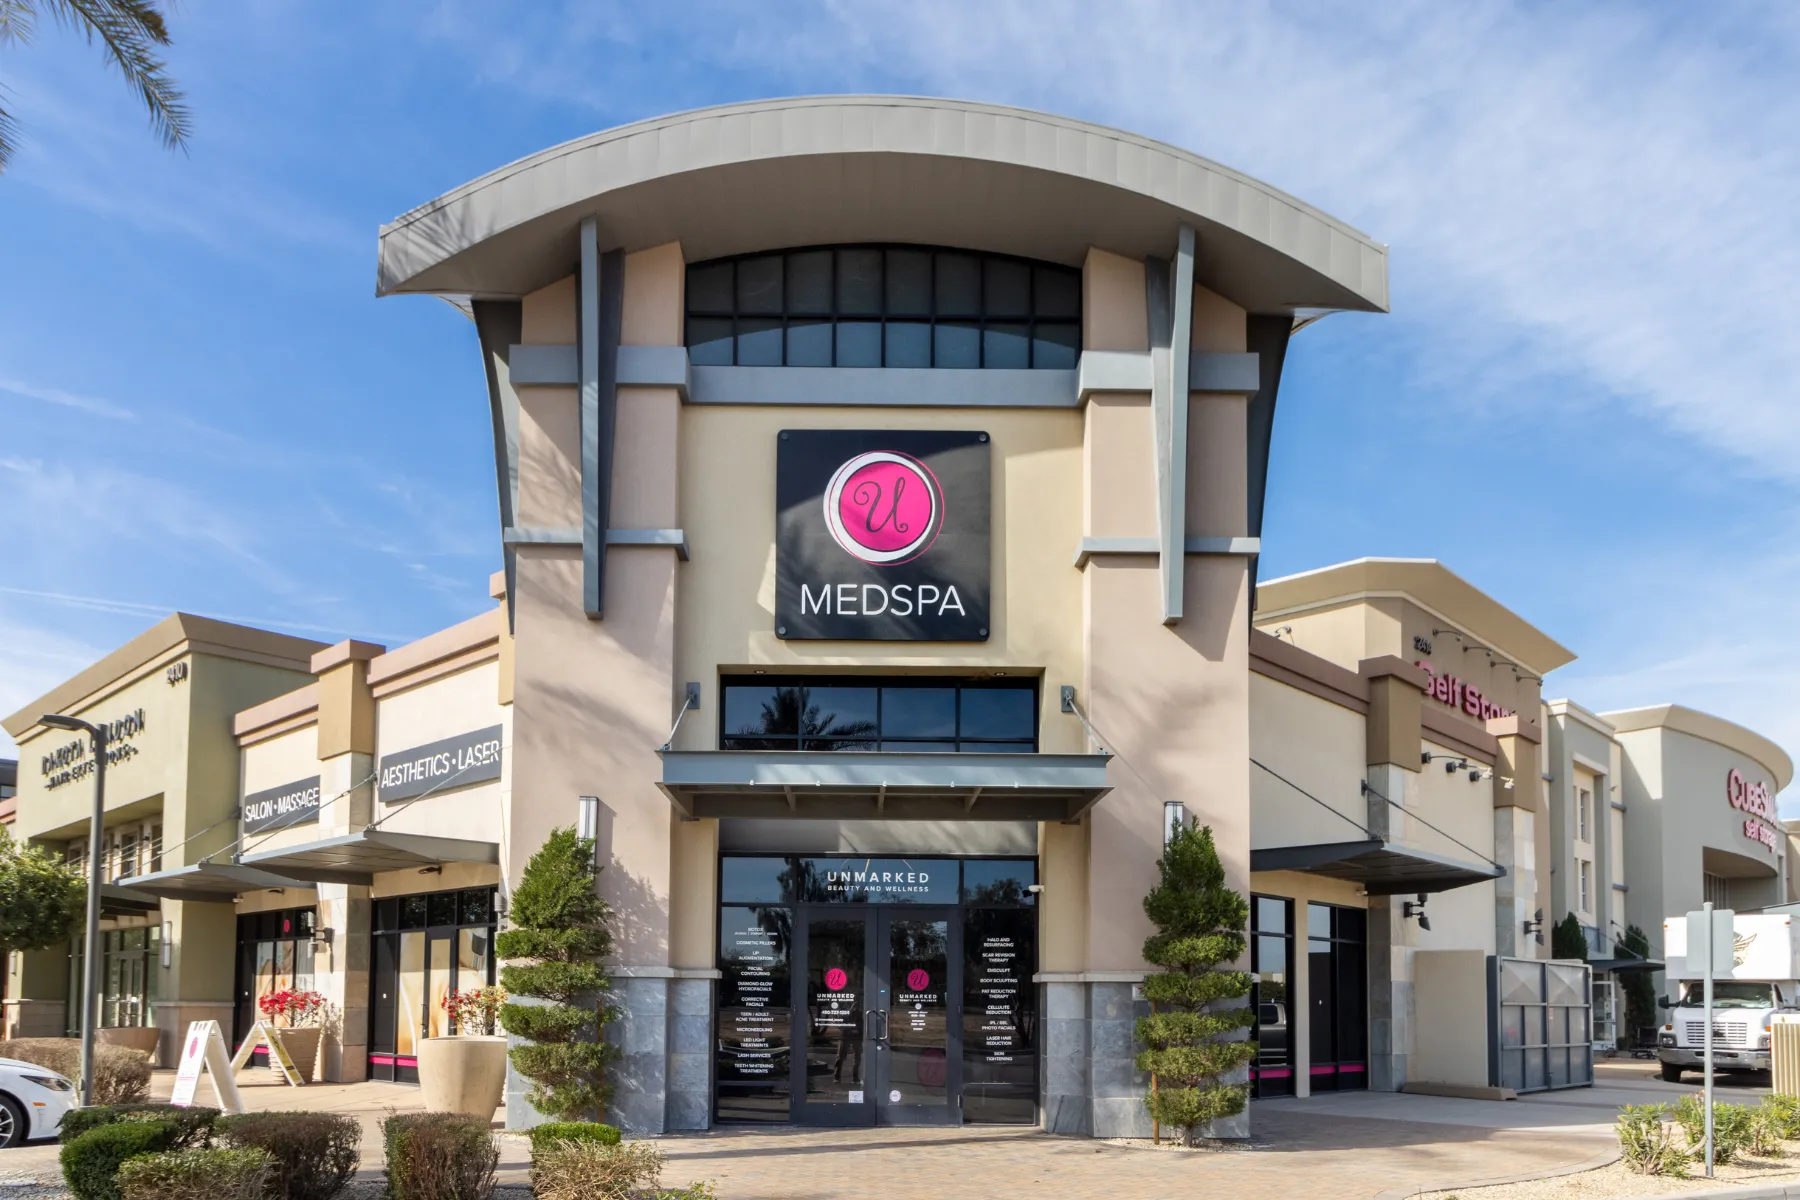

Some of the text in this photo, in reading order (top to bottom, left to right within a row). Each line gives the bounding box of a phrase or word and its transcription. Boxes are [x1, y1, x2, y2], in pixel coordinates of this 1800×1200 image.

[801, 583, 966, 616] MEDSPA
[89, 708, 146, 754] LNDON
[381, 740, 500, 788] AESTHETICS LASER
[245, 787, 320, 823] SALON MASSAGE
[827, 871, 929, 883] UNMARKED
